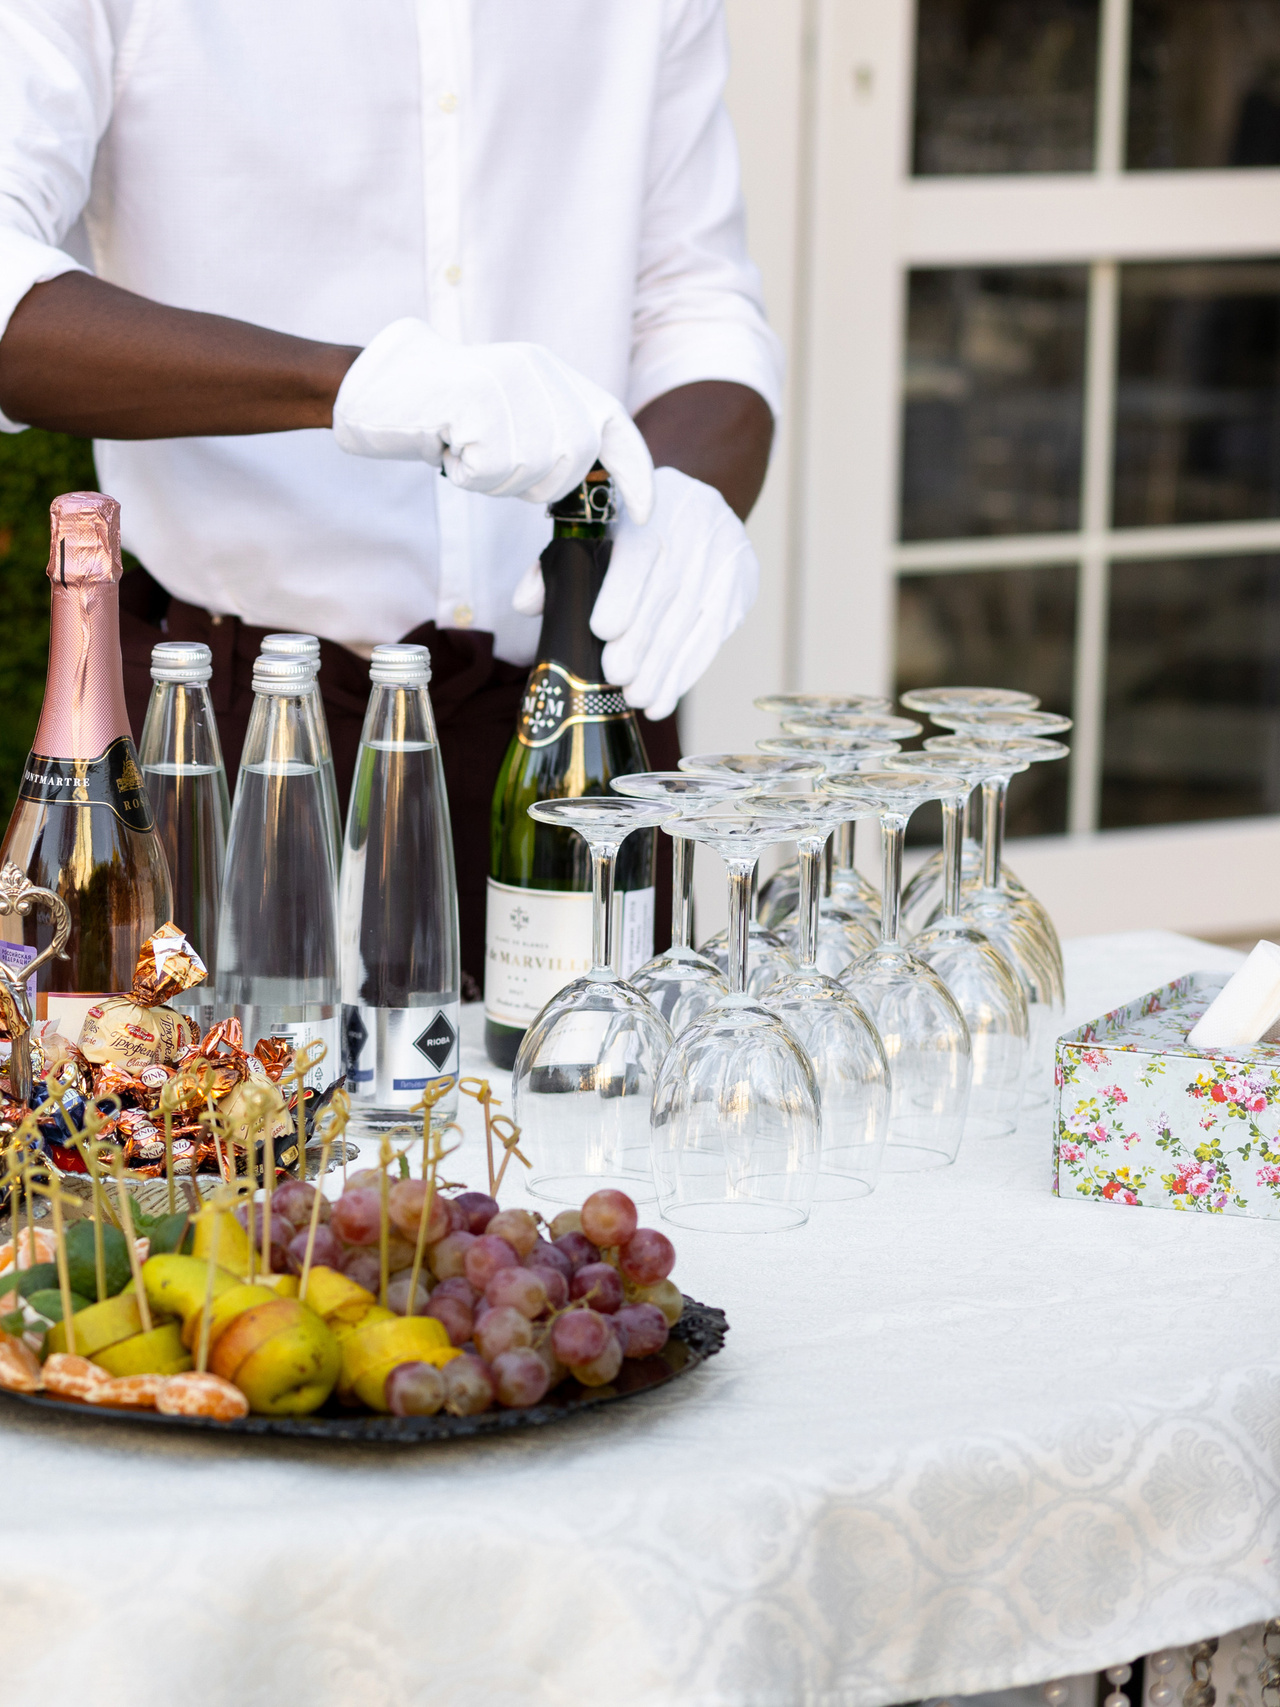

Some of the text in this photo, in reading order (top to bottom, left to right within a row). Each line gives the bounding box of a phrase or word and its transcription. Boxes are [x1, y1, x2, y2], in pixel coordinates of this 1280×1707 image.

[25, 769, 90, 787] ONTMARTRE
[1, 948, 32, 960] РОССИЙСКАЯ
[427, 1036, 450, 1047] RIOBA
[143, 1070, 165, 1083] PINK
